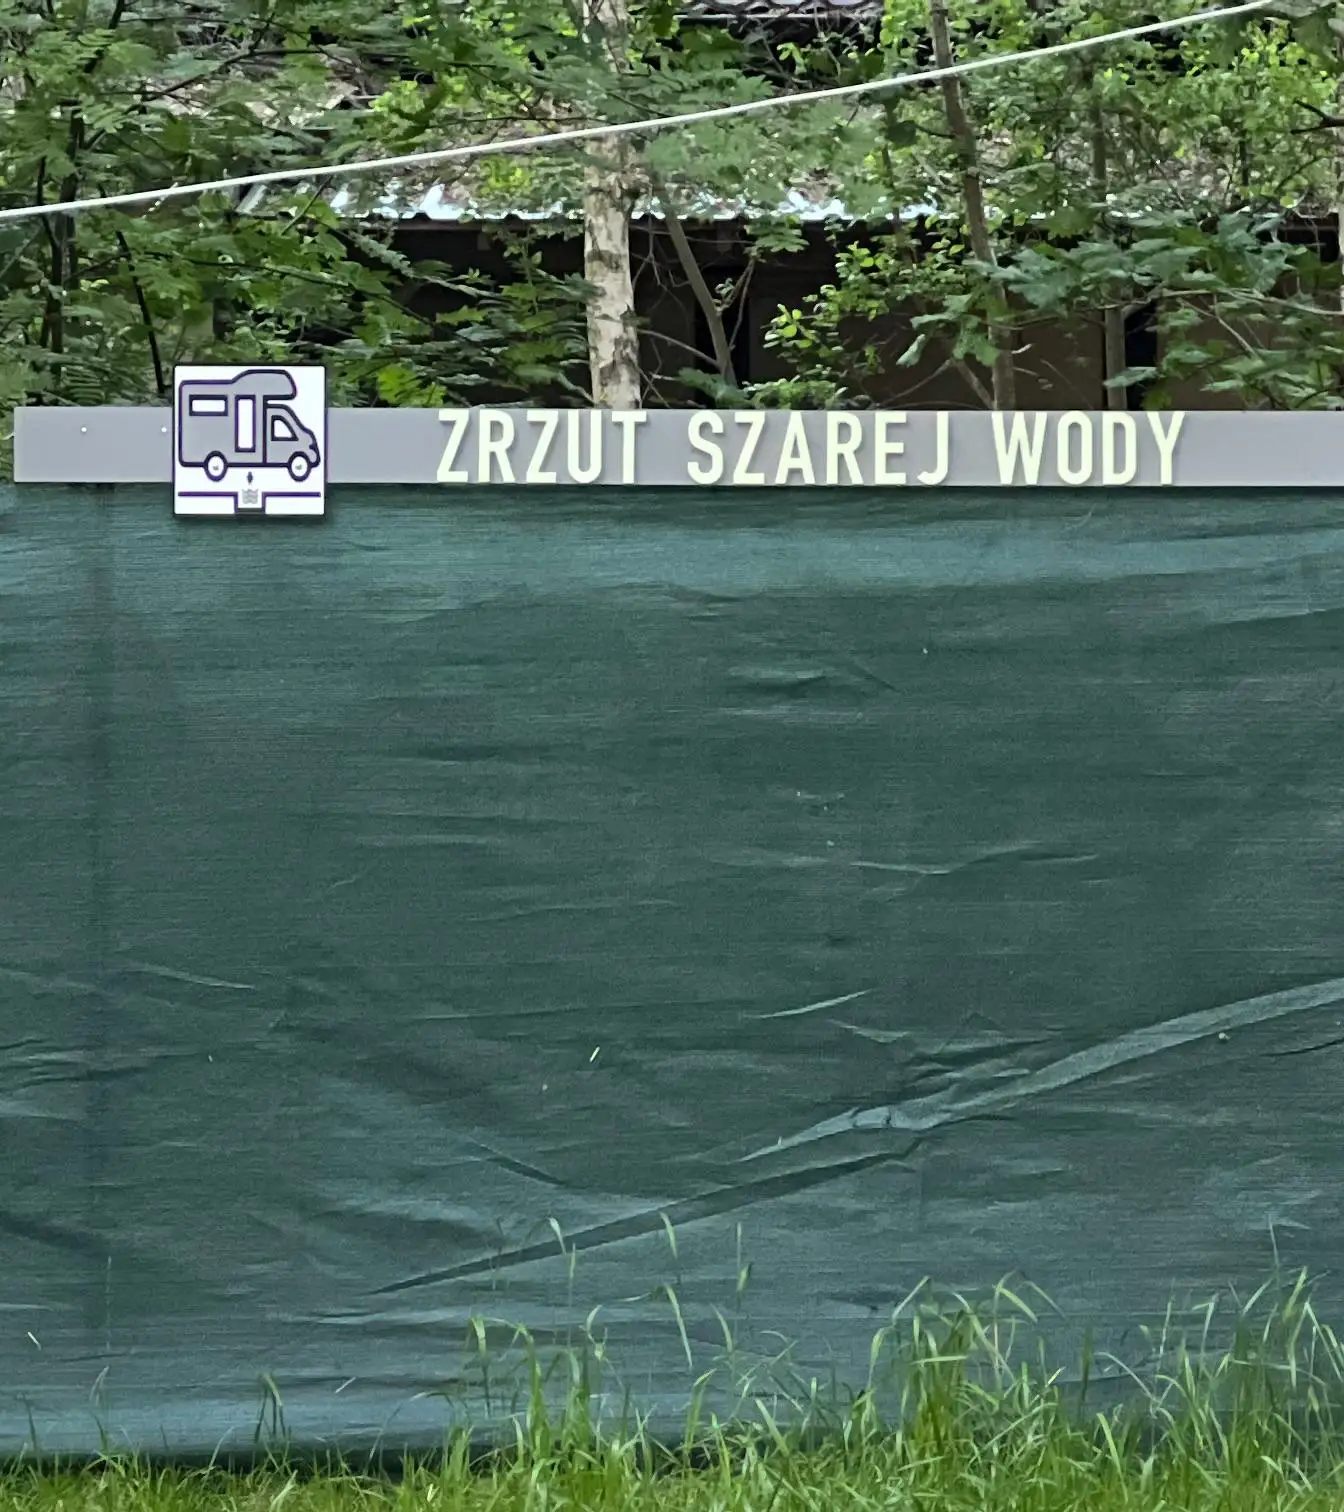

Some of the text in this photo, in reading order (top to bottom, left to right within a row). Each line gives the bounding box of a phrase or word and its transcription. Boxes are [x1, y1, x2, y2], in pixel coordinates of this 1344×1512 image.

[436, 408, 1186, 486] ZRZUT SZAREJ WODY
